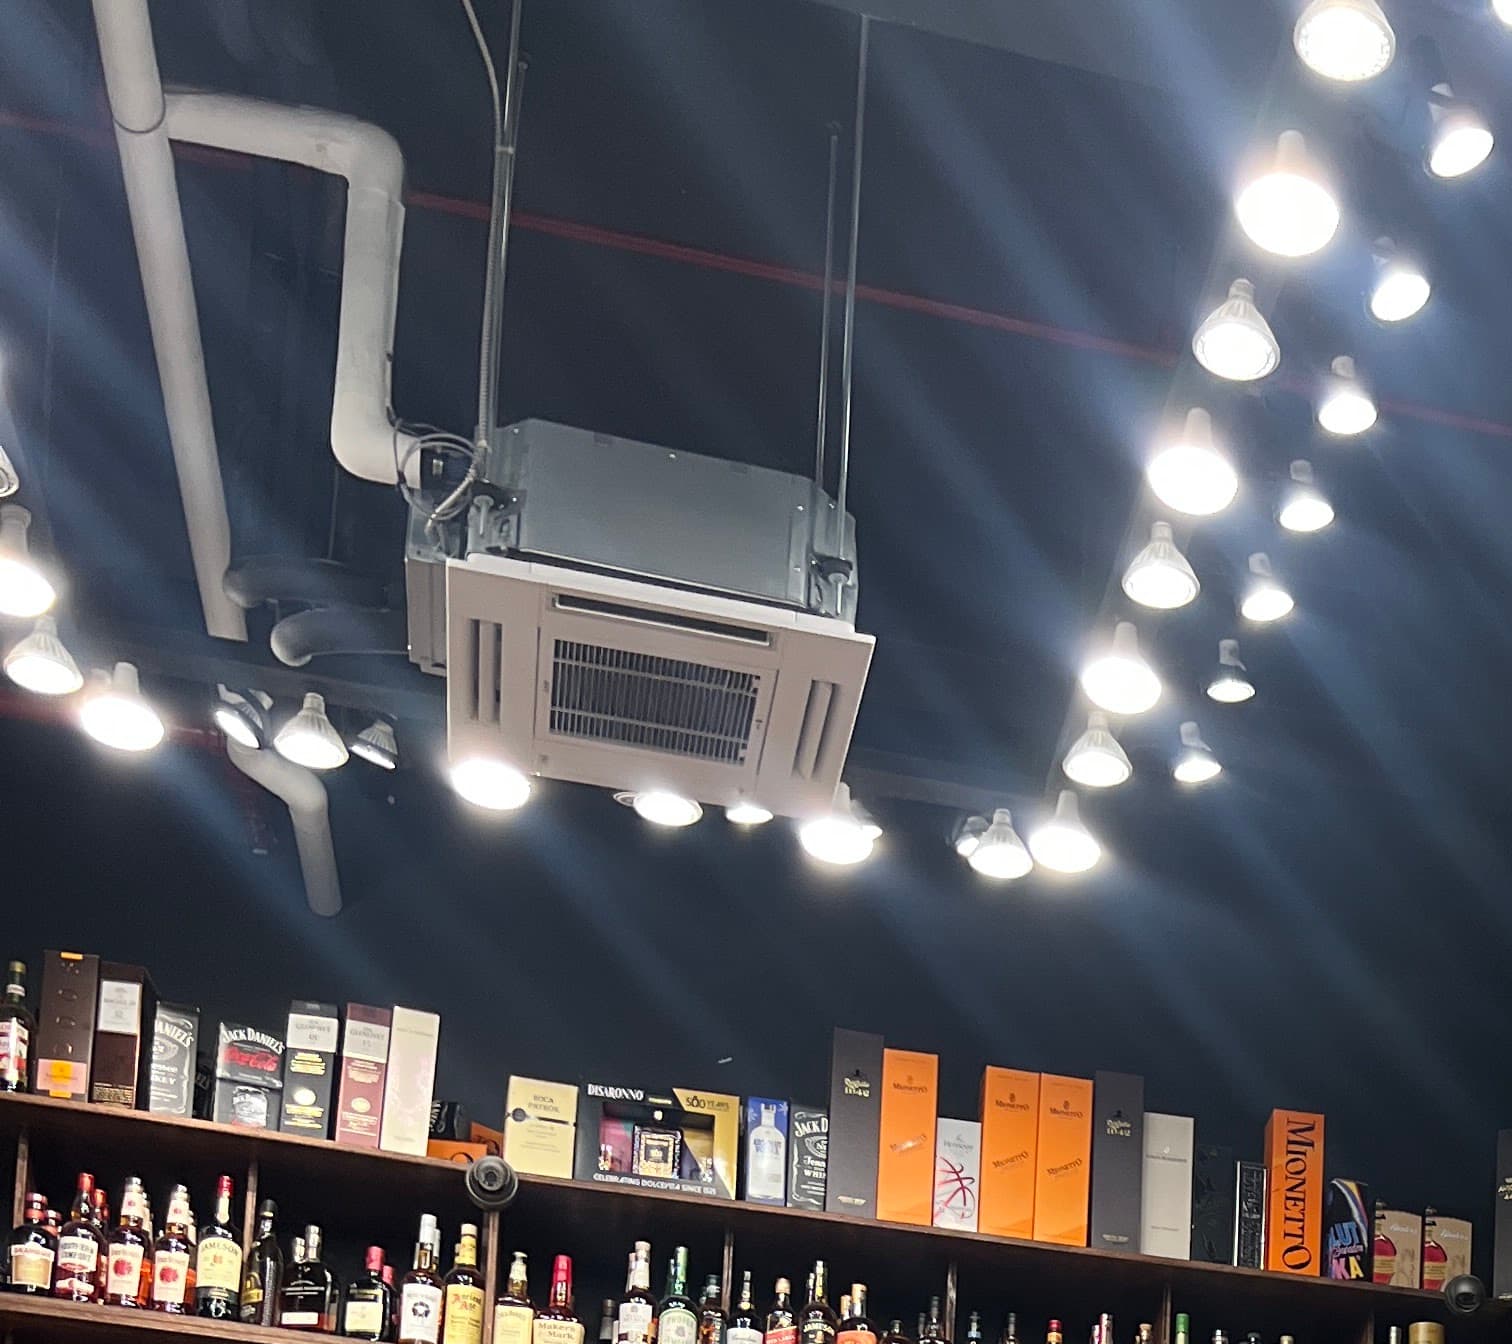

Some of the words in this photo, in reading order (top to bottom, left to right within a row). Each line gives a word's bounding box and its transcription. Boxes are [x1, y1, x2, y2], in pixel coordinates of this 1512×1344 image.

[247, 1028, 287, 1054] DANIEL'S
[587, 1083, 645, 1101] DISARONNO
[1281, 1118, 1316, 1271] MIONETTO
